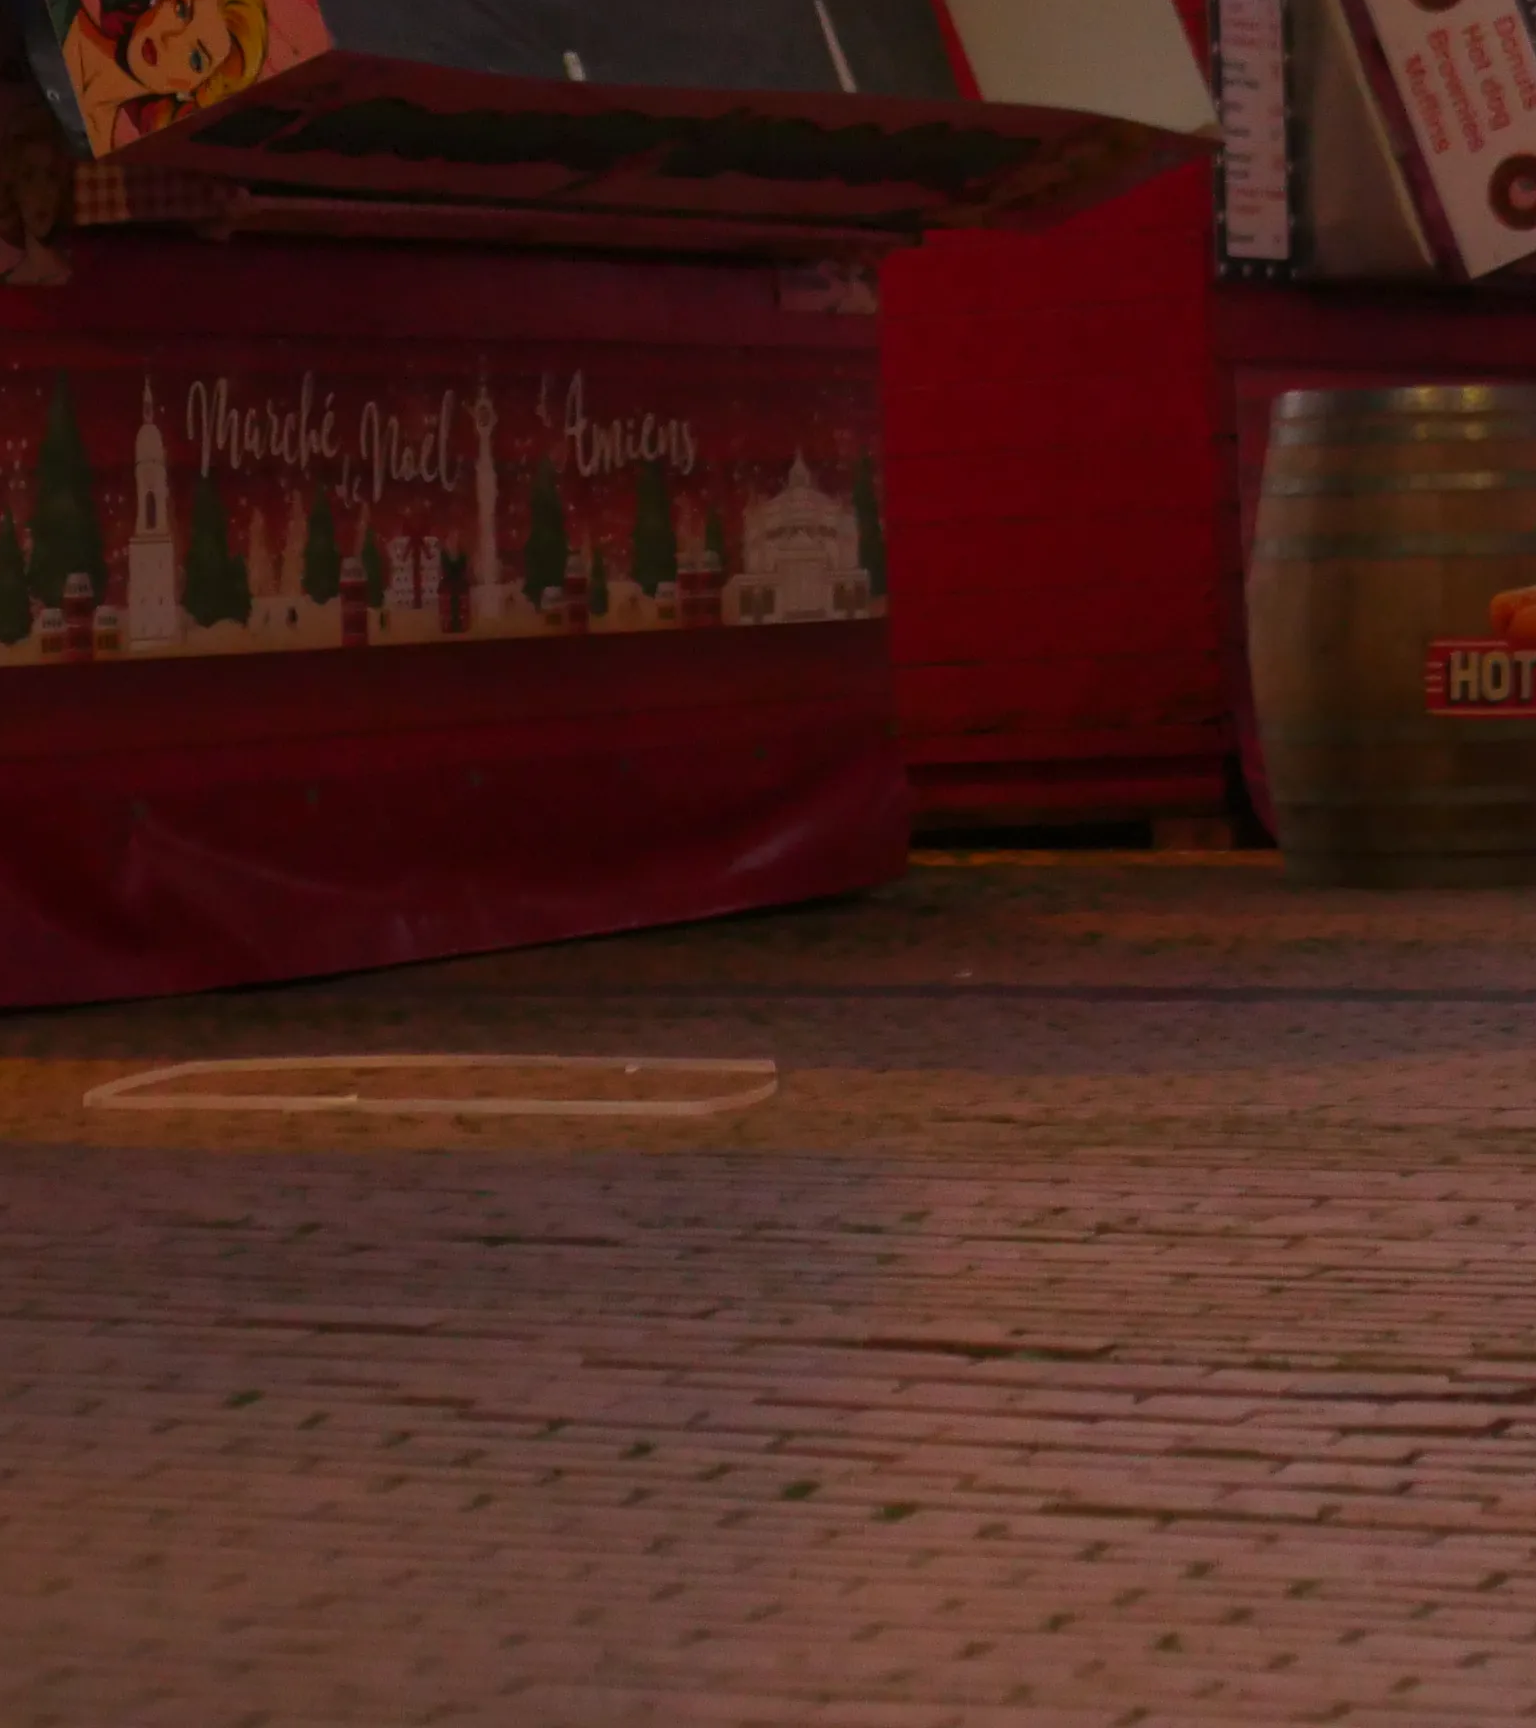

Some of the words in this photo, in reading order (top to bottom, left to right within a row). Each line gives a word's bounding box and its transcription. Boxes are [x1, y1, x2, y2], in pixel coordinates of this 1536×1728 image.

[1462, 24, 1492, 70] Hot
[186, 370, 343, 478] Marché
[360, 389, 464, 503] Noël
